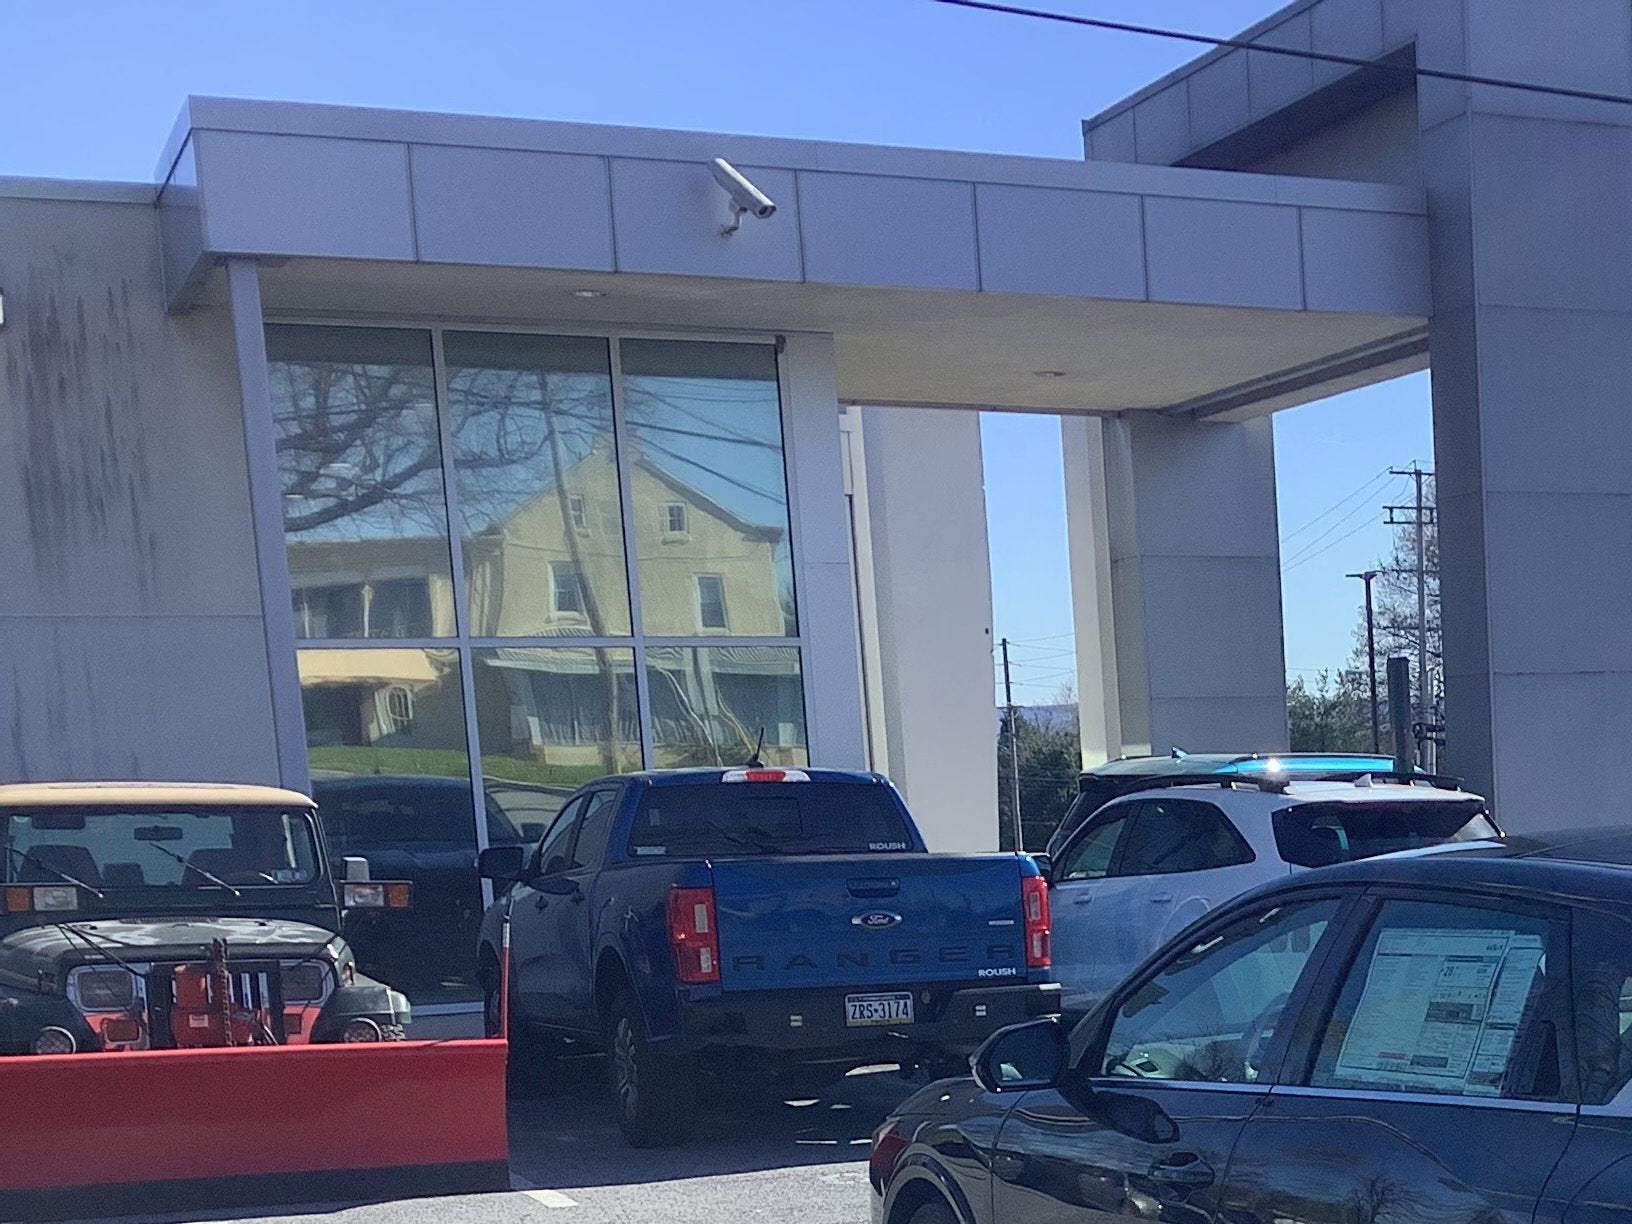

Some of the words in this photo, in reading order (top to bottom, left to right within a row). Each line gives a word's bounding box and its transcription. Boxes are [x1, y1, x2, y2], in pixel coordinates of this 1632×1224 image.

[869, 842, 907, 850] ROUSH
[867, 915, 889, 926] Ford
[731, 943, 1015, 971] RANGER
[978, 967, 1017, 977] ROUSH
